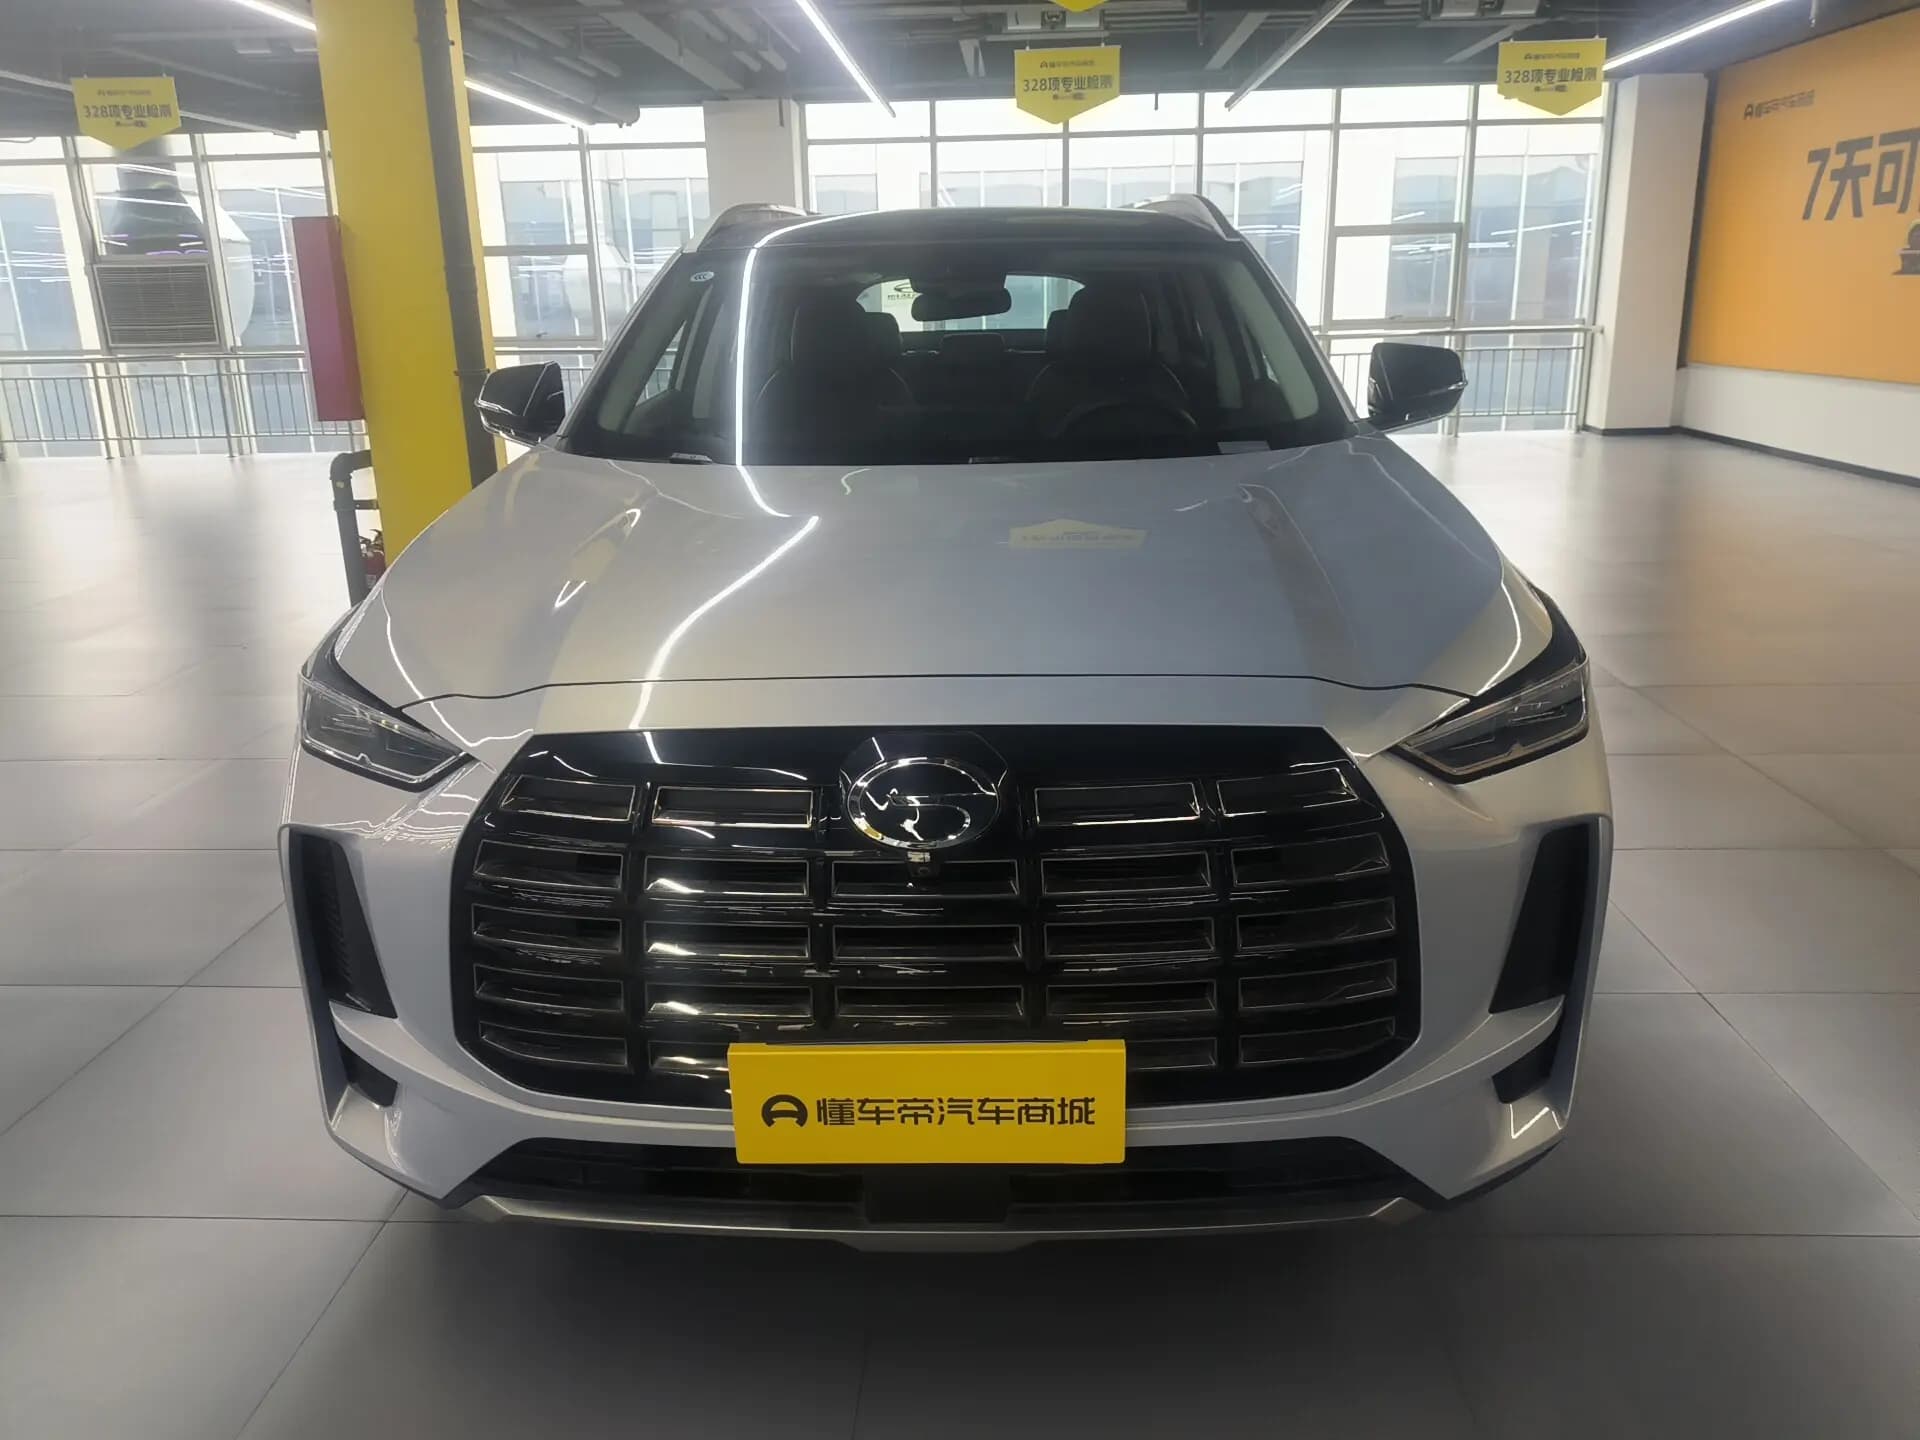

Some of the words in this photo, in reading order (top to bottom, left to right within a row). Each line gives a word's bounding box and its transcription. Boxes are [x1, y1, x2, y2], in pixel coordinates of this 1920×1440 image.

[816, 1097, 1095, 1126] 懂车帝汽车商城
